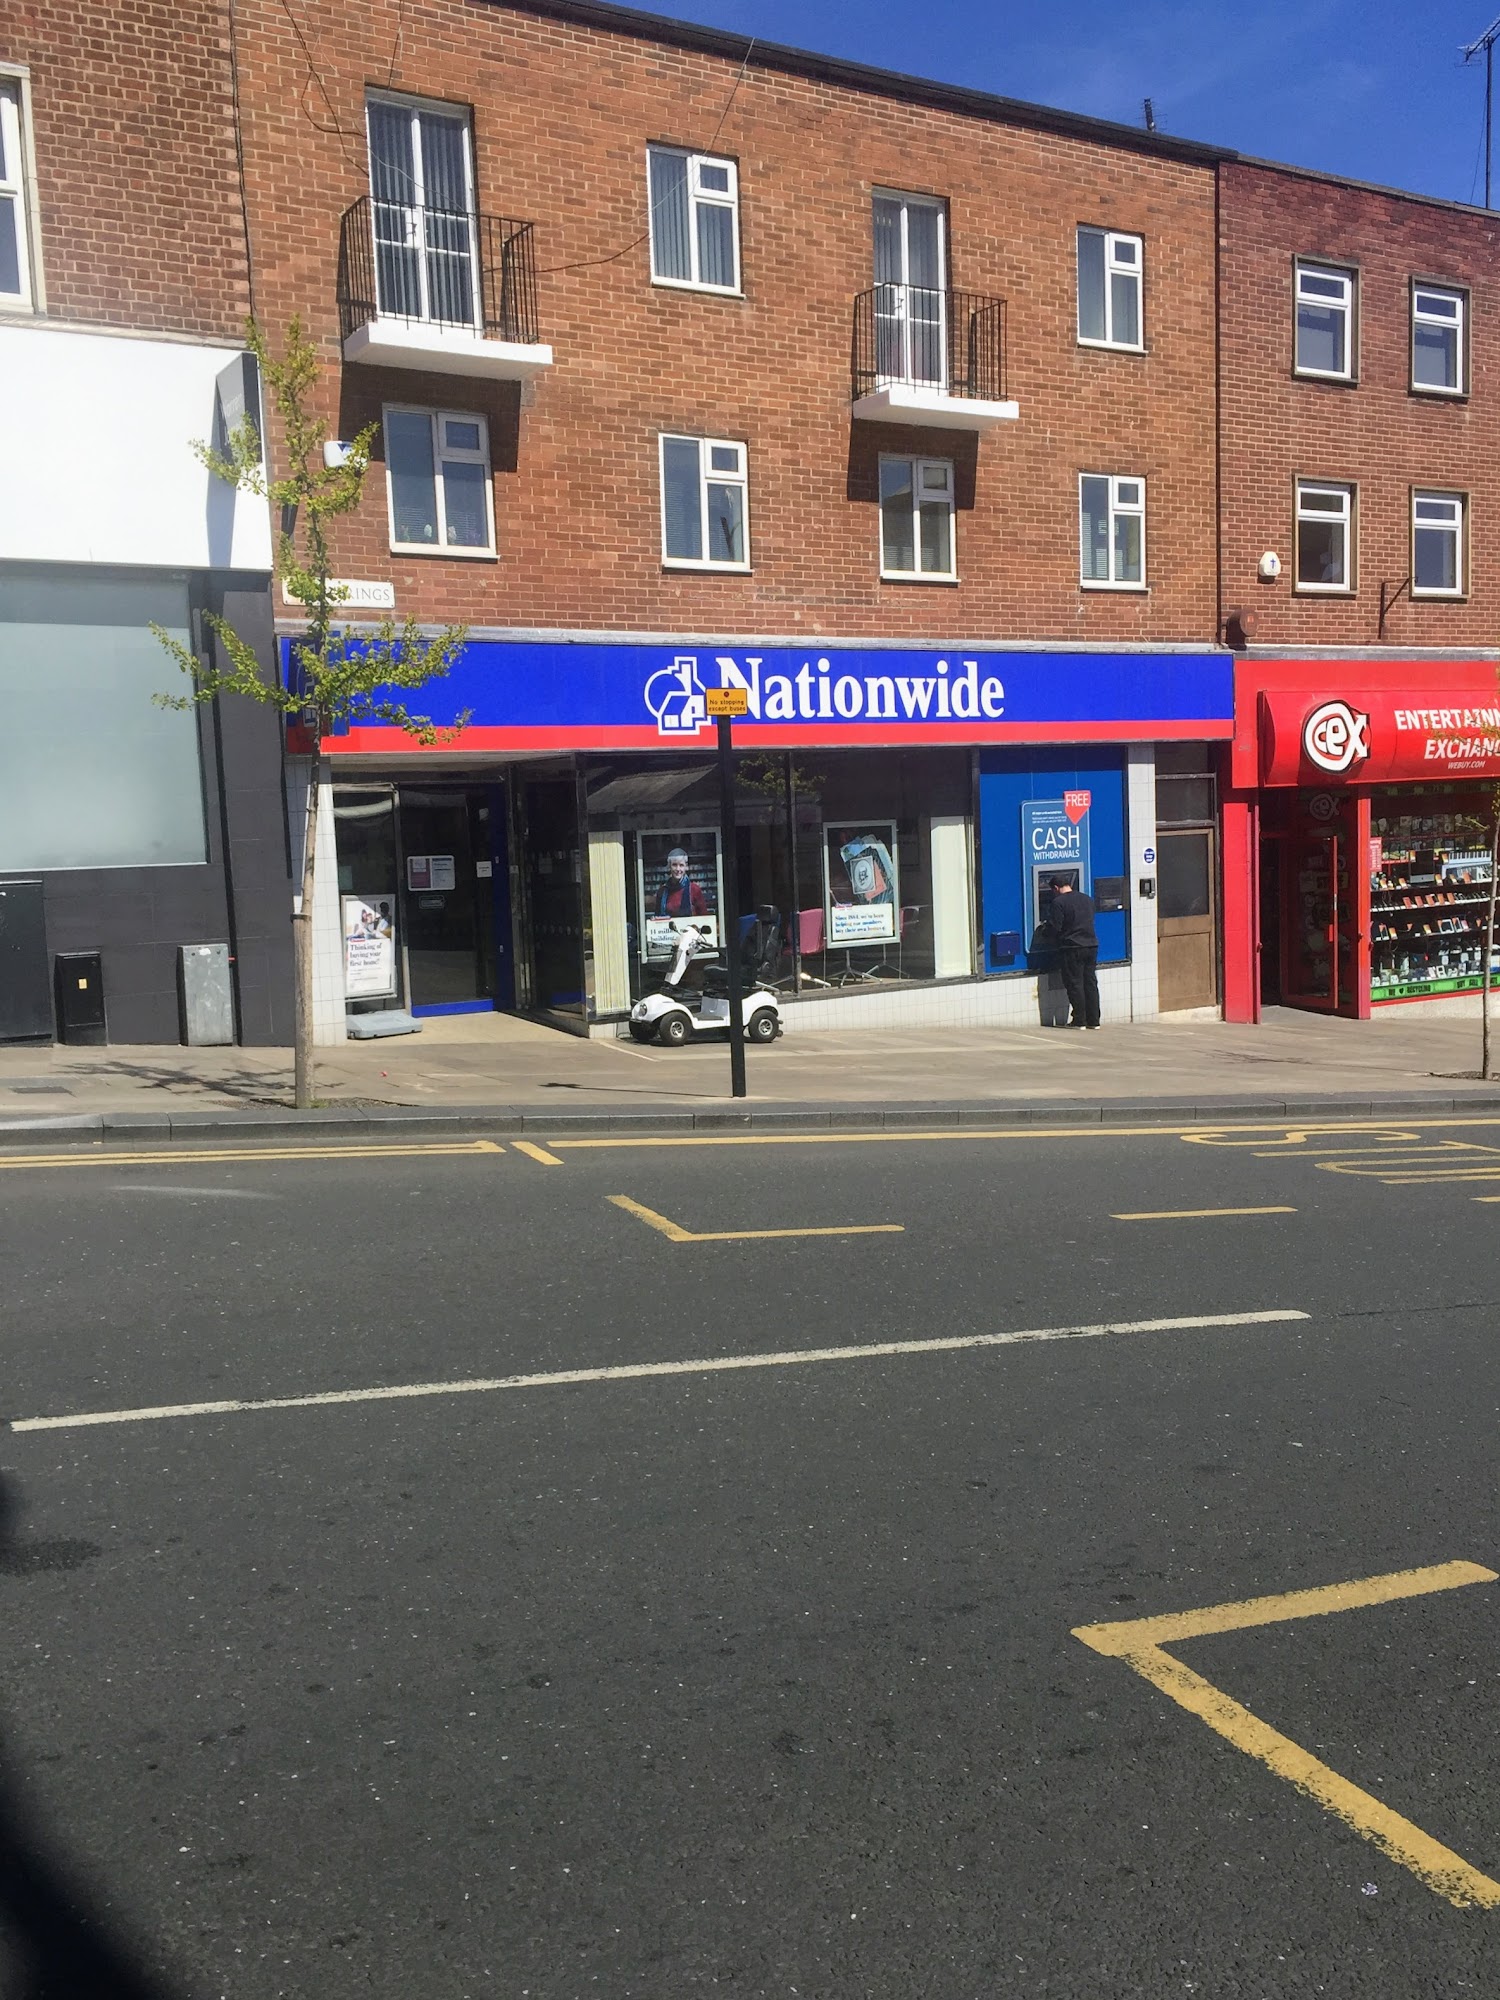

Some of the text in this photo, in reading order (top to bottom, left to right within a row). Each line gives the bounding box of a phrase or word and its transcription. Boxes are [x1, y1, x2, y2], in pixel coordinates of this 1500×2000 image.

[715, 657, 1005, 719] Nationwide
[1448, 761, 1485, 769] WEBUY.COM
[1065, 793, 1090, 807] FREE
[1032, 826, 1080, 850] CASH
[1033, 849, 1080, 860] WITHDRAWALS
[350, 943, 375, 951] Thinking
[349, 951, 369, 959] buying
